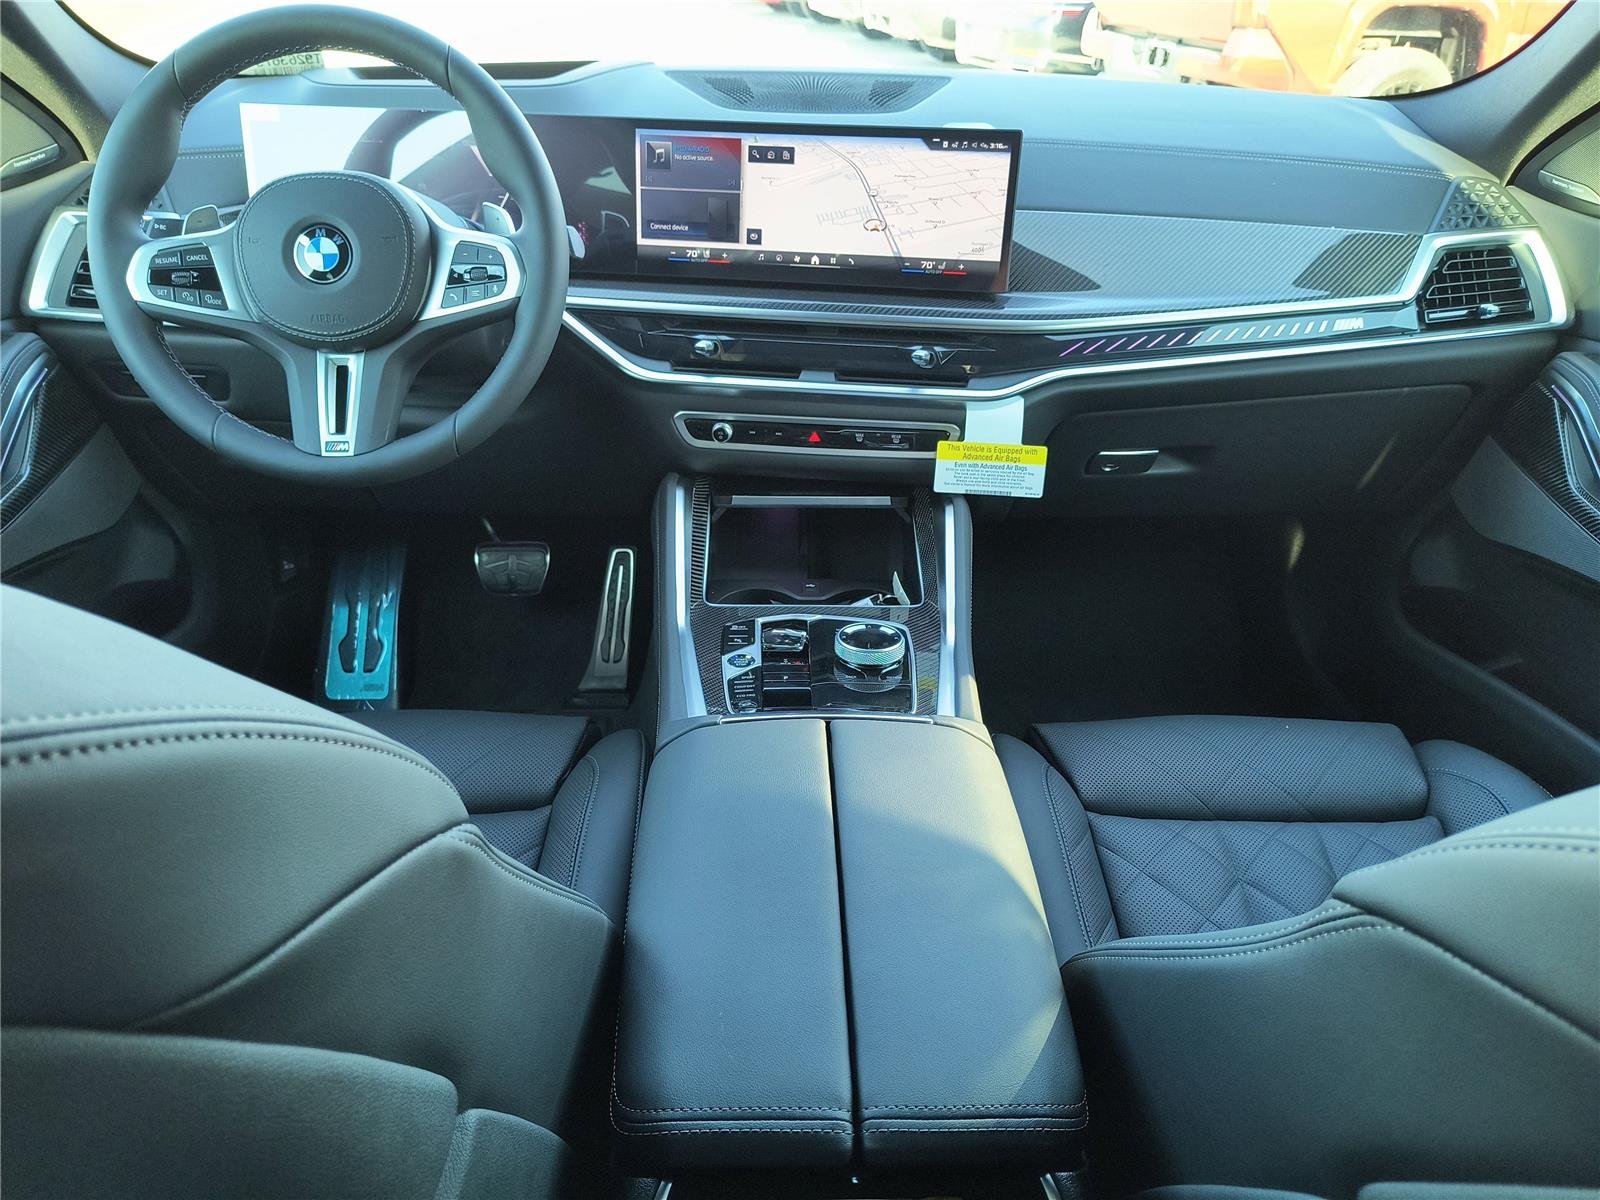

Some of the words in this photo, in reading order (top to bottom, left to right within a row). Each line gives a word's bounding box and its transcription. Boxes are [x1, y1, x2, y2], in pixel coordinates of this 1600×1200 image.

[650, 222, 671, 231] Connect
[672, 223, 688, 231] device
[155, 256, 179, 264] RESUME
[310, 314, 345, 324] AIRBAG
[947, 443, 961, 451] This
[962, 445, 985, 453] Vehicle
[993, 447, 1023, 456] Equipped
[1024, 448, 1038, 456] with
[962, 453, 993, 461] Advanced
[1005, 455, 1021, 464] Bags
[980, 463, 1005, 471] Advanced
[1014, 465, 1028, 473] Bags
